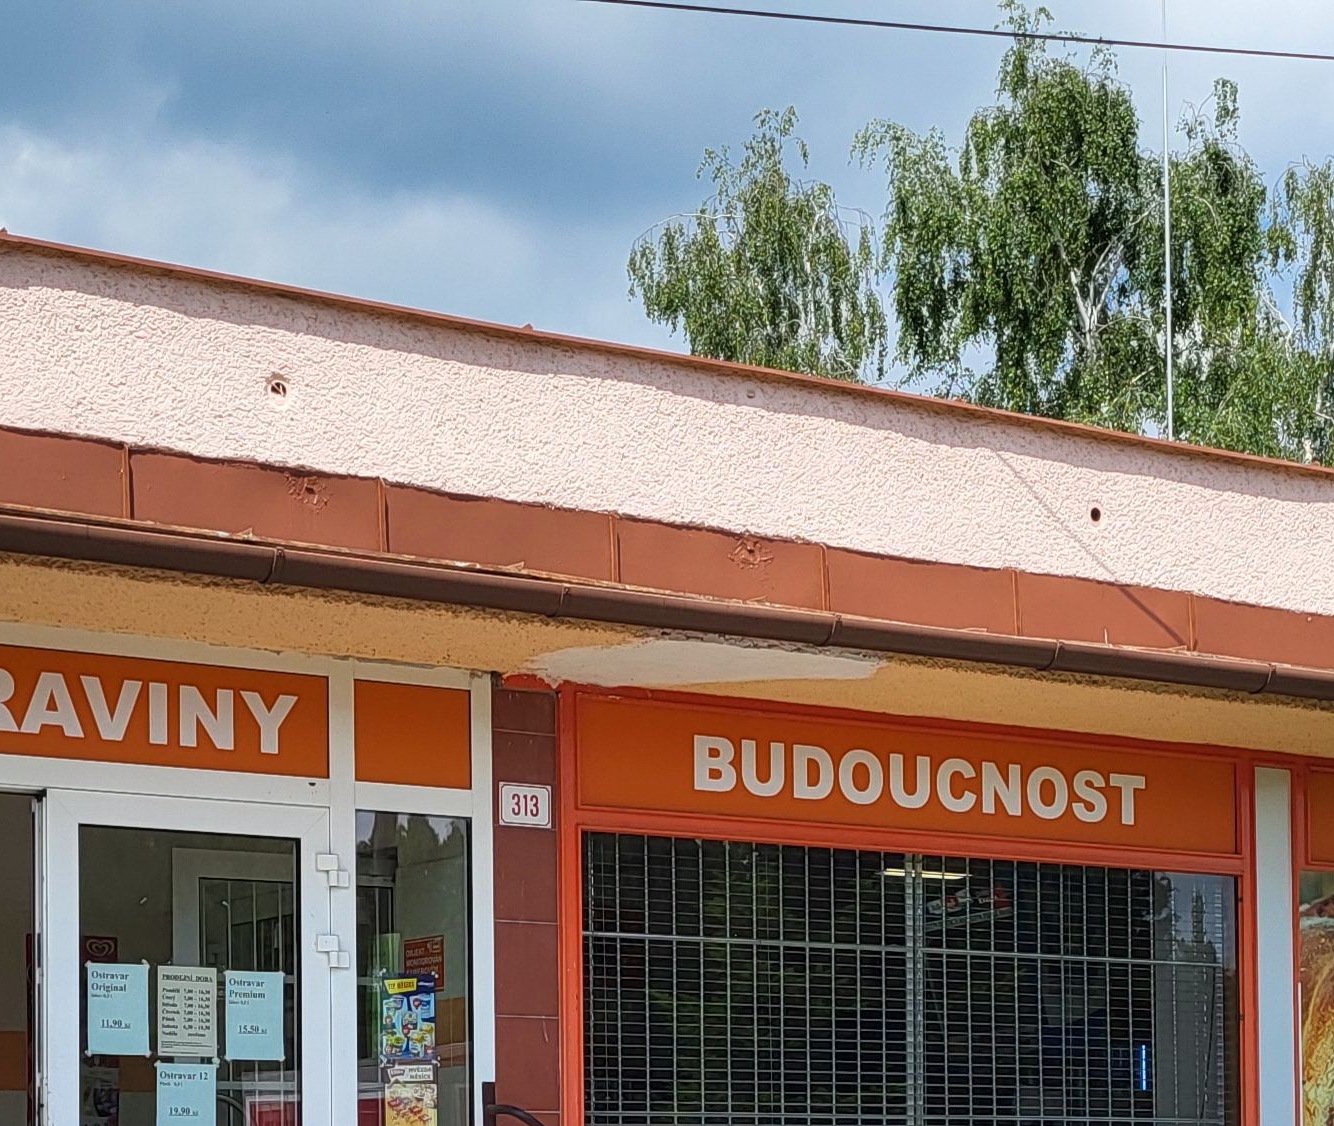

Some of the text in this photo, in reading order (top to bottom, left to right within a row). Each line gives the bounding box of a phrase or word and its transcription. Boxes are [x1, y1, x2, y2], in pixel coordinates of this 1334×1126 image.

[693, 734, 1146, 826] BUDOUCNOST
[511, 793, 540, 817] 313
[91, 970, 129, 981] Ostravar
[195, 975, 213, 983] DOBA
[91, 982, 127, 993] Original
[229, 977, 266, 988] Ostravar
[229, 989, 266, 999] Premium
[159, 1070, 208, 1081] Ostravar 12
[409, 1072, 431, 1080] MĚSÍCE
